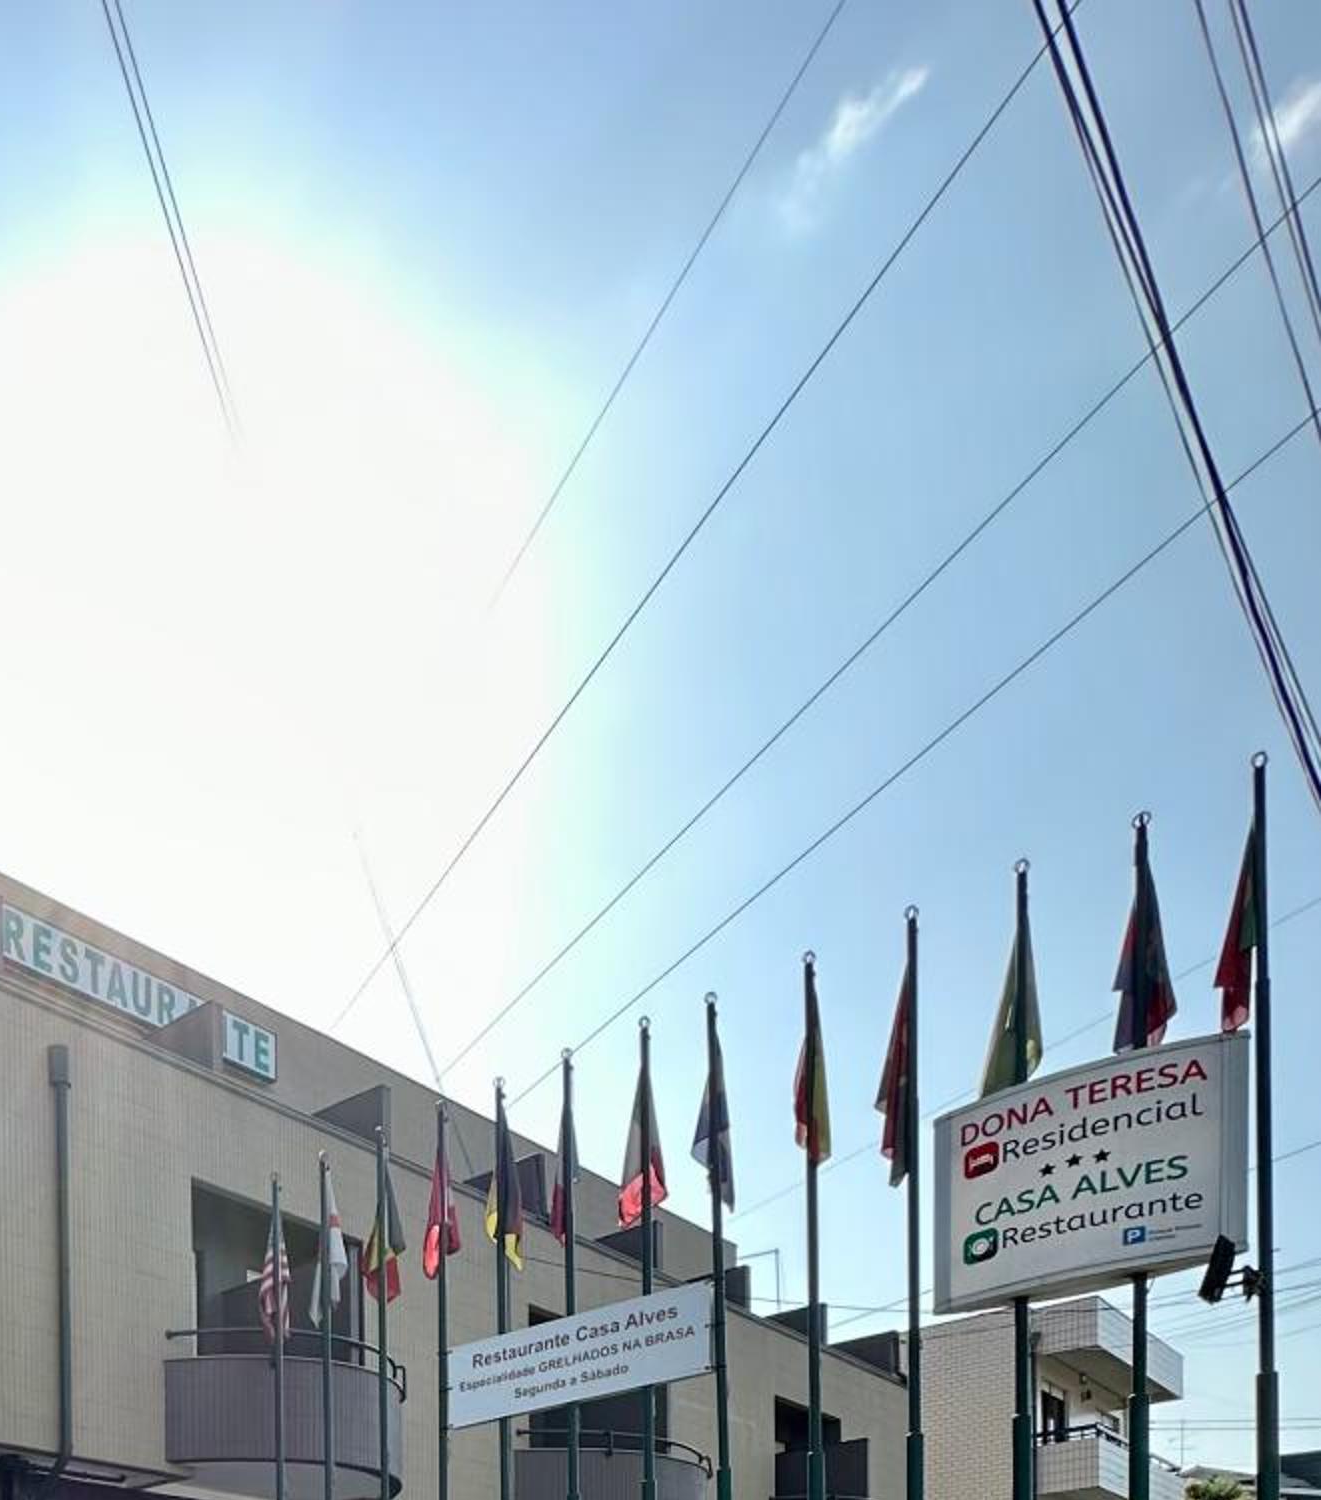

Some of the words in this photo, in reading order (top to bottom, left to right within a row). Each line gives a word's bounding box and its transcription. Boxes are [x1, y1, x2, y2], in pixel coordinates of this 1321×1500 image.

[3, 908, 270, 1074] RESTAURTE
[960, 1097, 1053, 1147] DONA
[1065, 1059, 1208, 1110] TERESA
[1002, 1093, 1204, 1163] Residencial
[975, 1184, 1060, 1226] CASA
[1071, 1155, 1189, 1200] ALVES
[1002, 1192, 1203, 1249] Restaurante
[459, 1365, 535, 1393] Especialidade
[538, 1343, 619, 1373] GRELHADOS
[622, 1339, 642, 1352] NA
[645, 1325, 695, 1347] BRASA
[472, 1332, 570, 1369] Restaurante
[576, 1320, 620, 1341] Casa
[624, 1306, 678, 1331] Alves
[514, 1377, 566, 1399] Segunda
[570, 1377, 578, 1386] a
